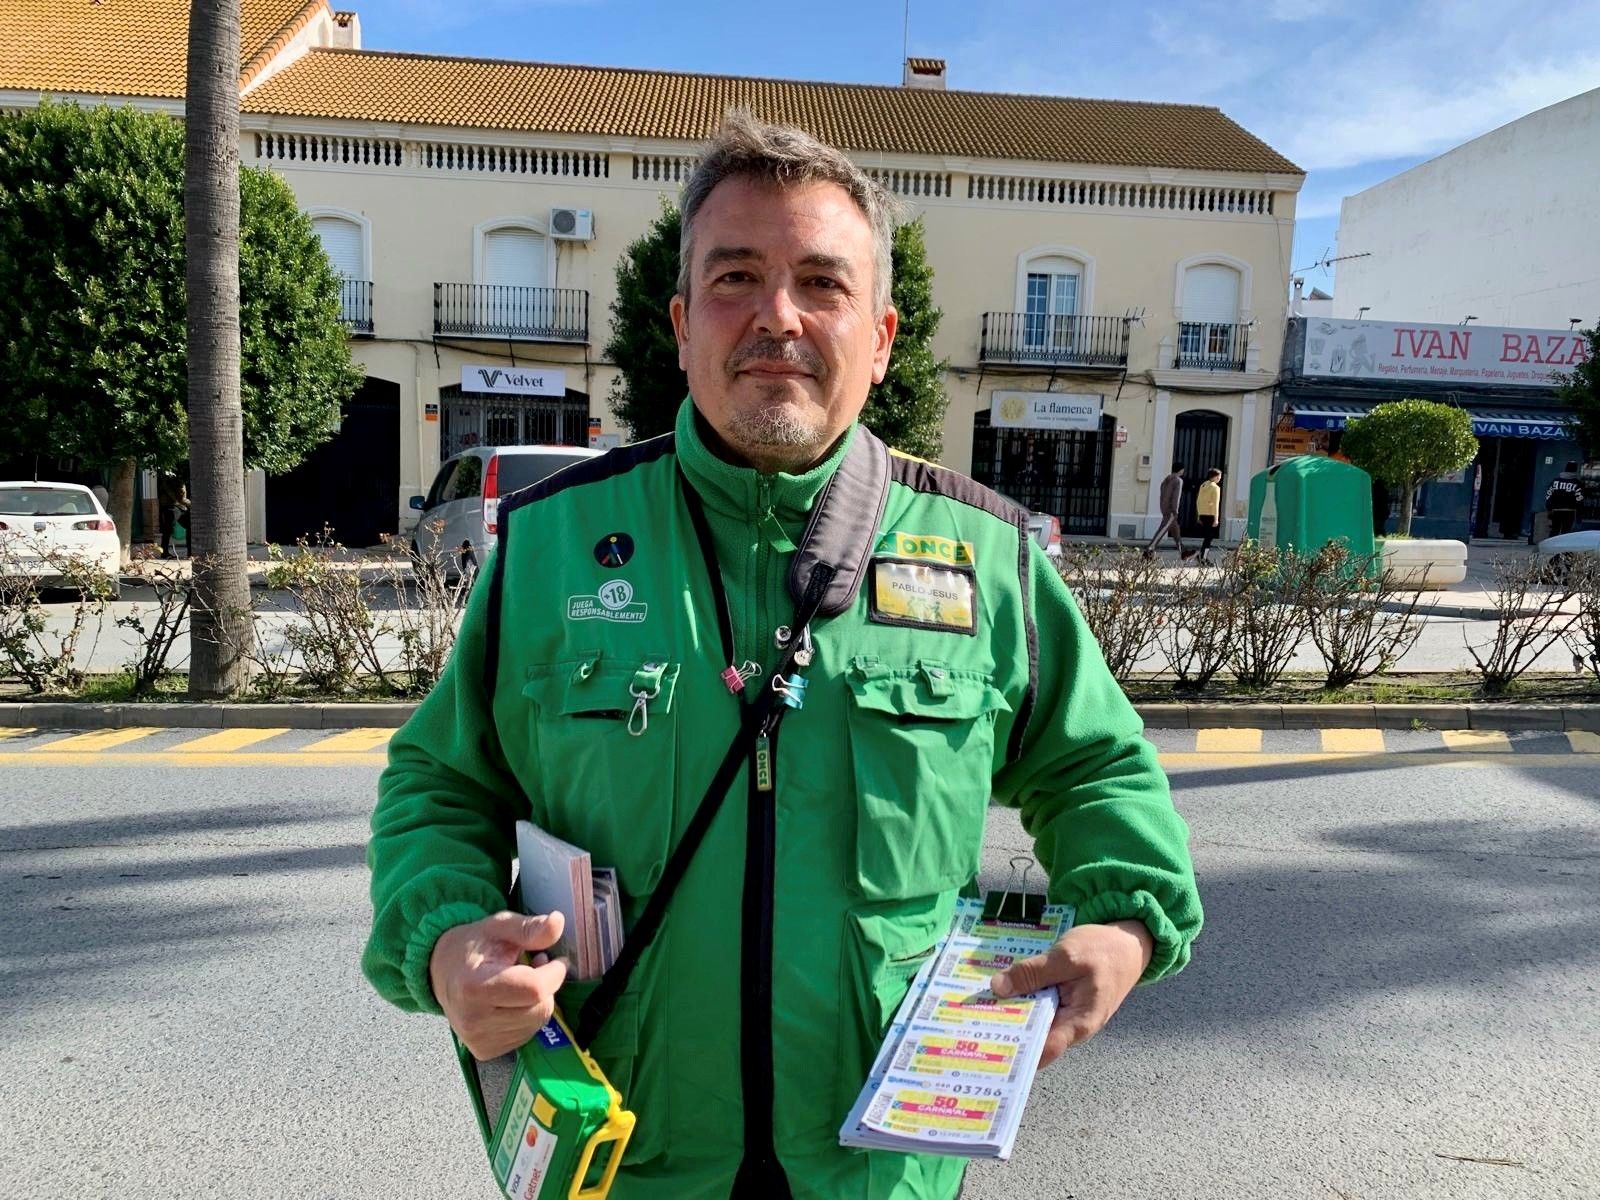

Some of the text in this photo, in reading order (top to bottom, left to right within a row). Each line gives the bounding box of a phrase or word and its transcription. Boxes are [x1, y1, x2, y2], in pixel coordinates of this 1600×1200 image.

[1391, 328, 1587, 365] IVAN BAZA
[504, 374, 544, 387] Velvet
[1034, 401, 1092, 414] La flamenca
[1472, 423, 1567, 437] IVAN BAZA
[902, 539, 967, 562] ONCE
[604, 585, 627, 604] +18
[892, 581, 958, 601] PABLO JESUS
[571, 608, 645, 620] RESPONSABLEMENTE
[572, 600, 594, 609] JUEGA
[758, 753, 768, 786] ONCE
[934, 1095, 959, 1108] 50
[506, 1090, 530, 1150] ONCE
[510, 1173, 522, 1194] VISA
[523, 1168, 542, 1200] Getnet
